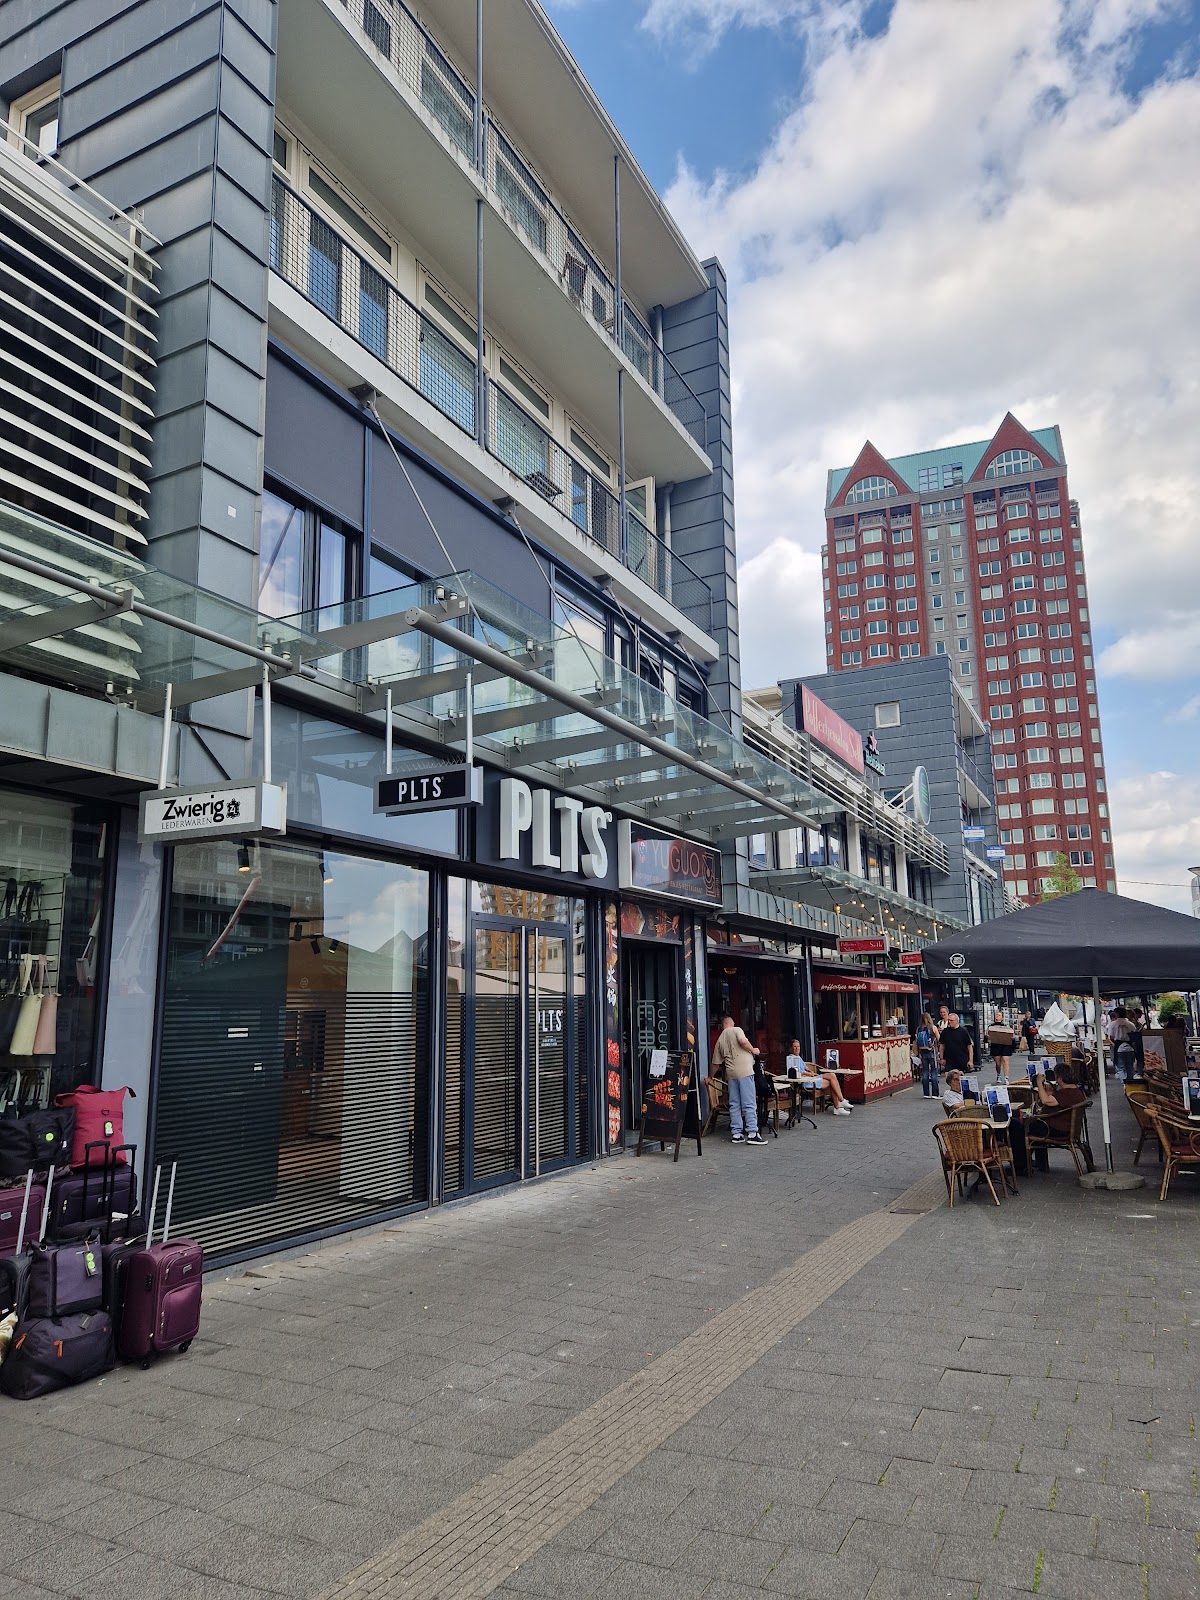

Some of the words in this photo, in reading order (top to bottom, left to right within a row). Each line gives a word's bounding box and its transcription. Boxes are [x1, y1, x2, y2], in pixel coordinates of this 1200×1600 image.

[398, 776, 443, 803] PLTS
[162, 794, 225, 823] Zwierig
[161, 817, 213, 830] LEDERWAREN
[651, 839, 700, 878] YUGUO
